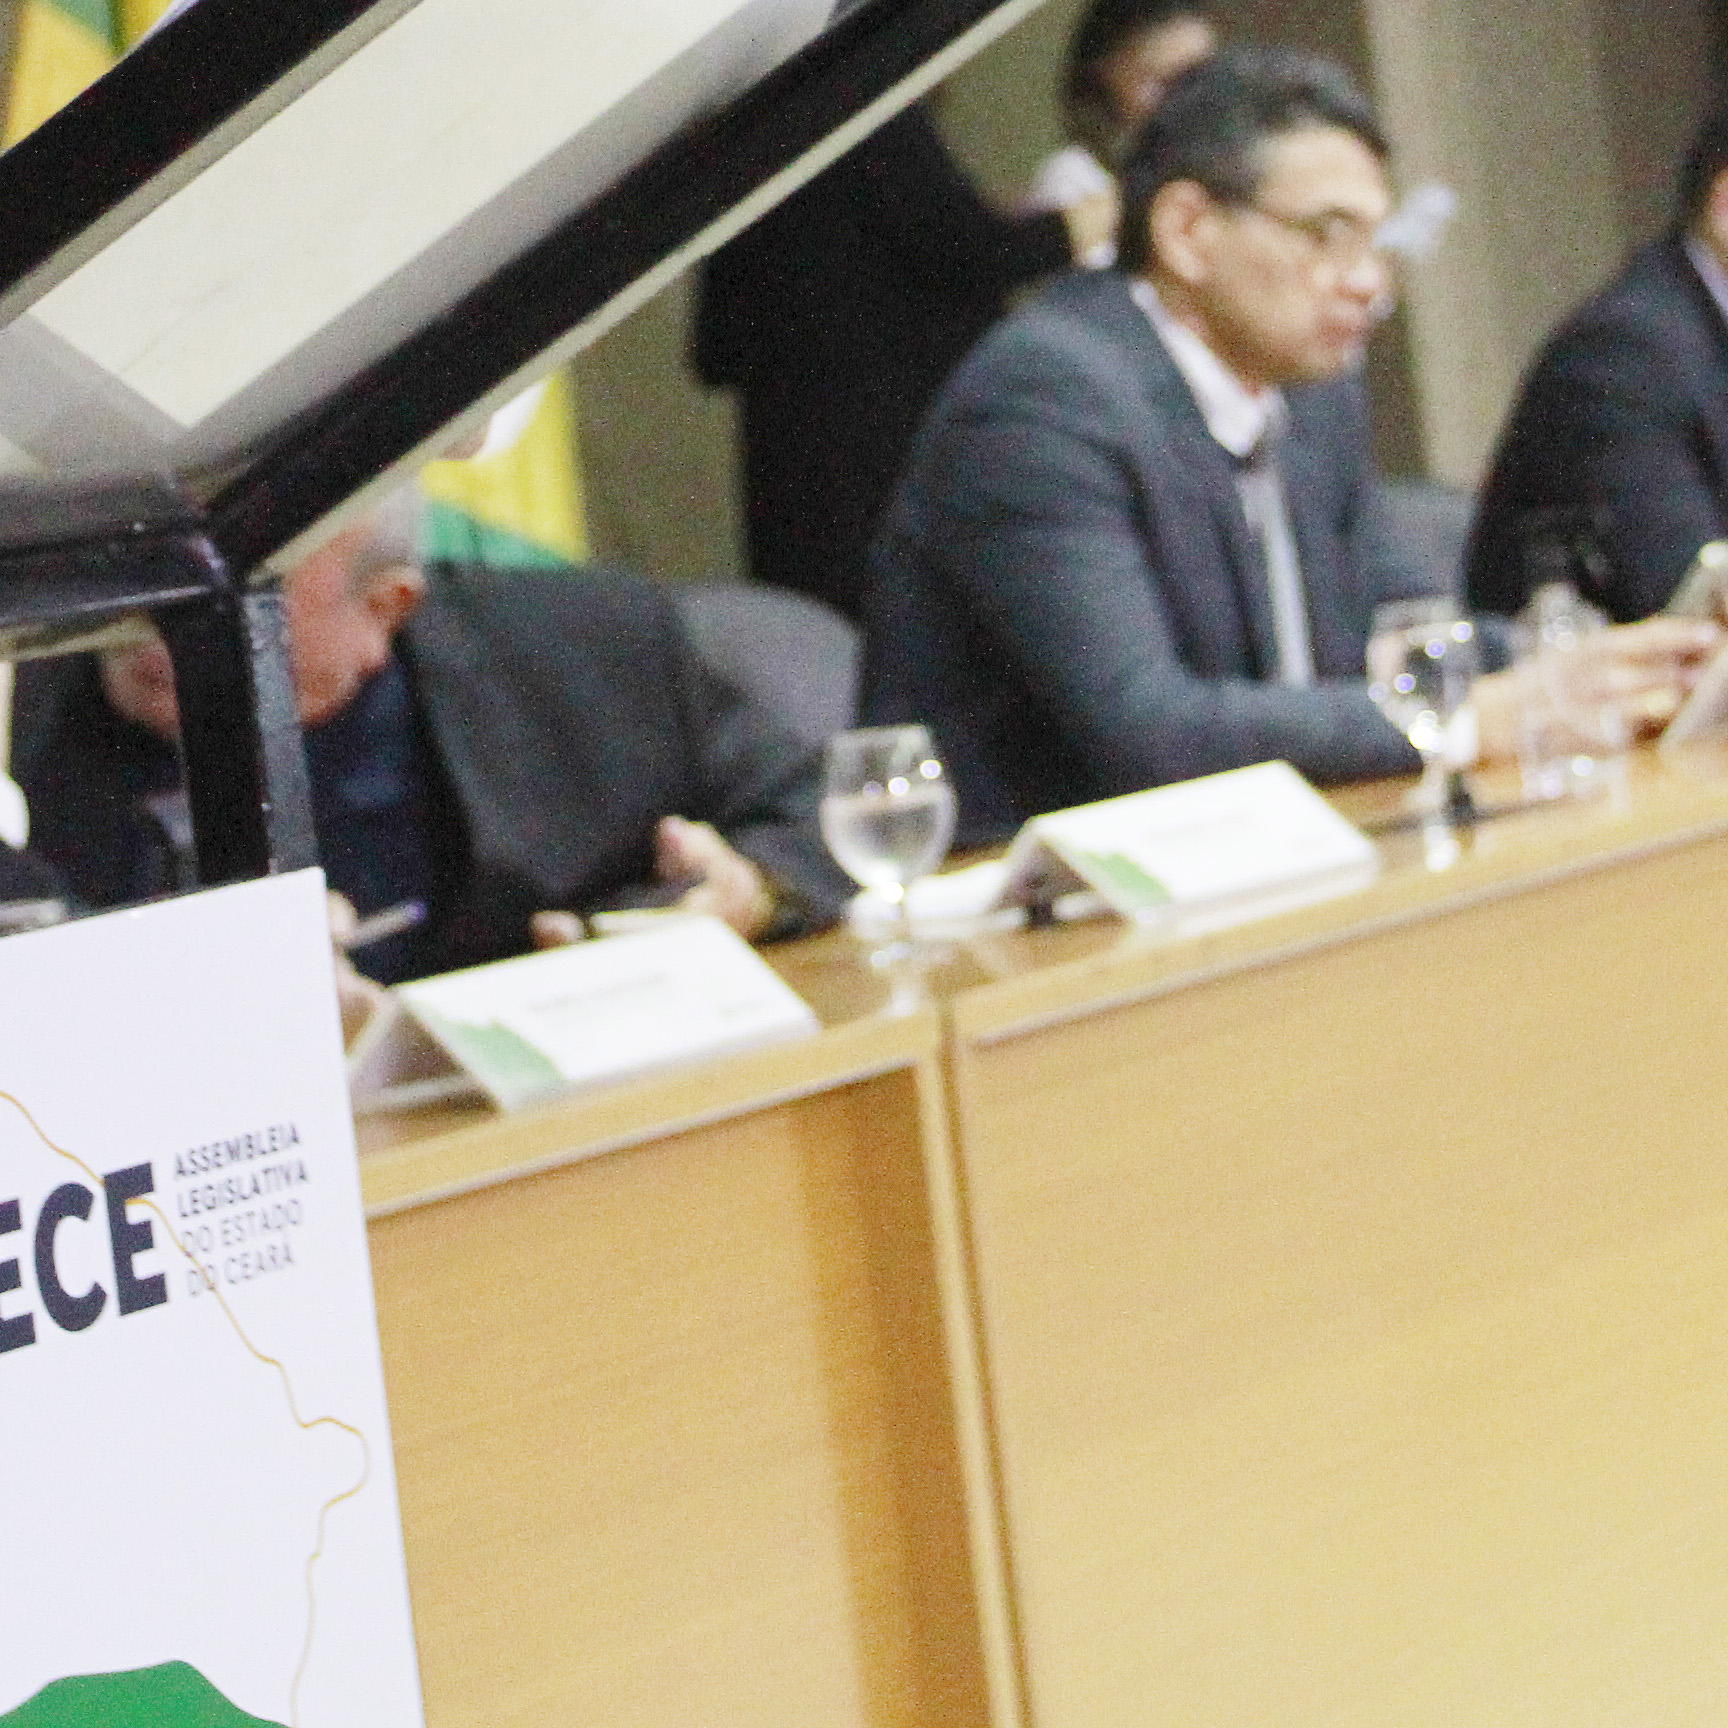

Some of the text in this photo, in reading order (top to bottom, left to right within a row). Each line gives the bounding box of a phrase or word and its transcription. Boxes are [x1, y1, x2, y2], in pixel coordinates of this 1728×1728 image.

[174, 1120, 301, 1178] ASSEMBLEIA
[176, 1158, 309, 1219] LEGISLATIVA
[182, 1198, 301, 1257] DO ESTADO
[187, 1262, 218, 1298] DO
